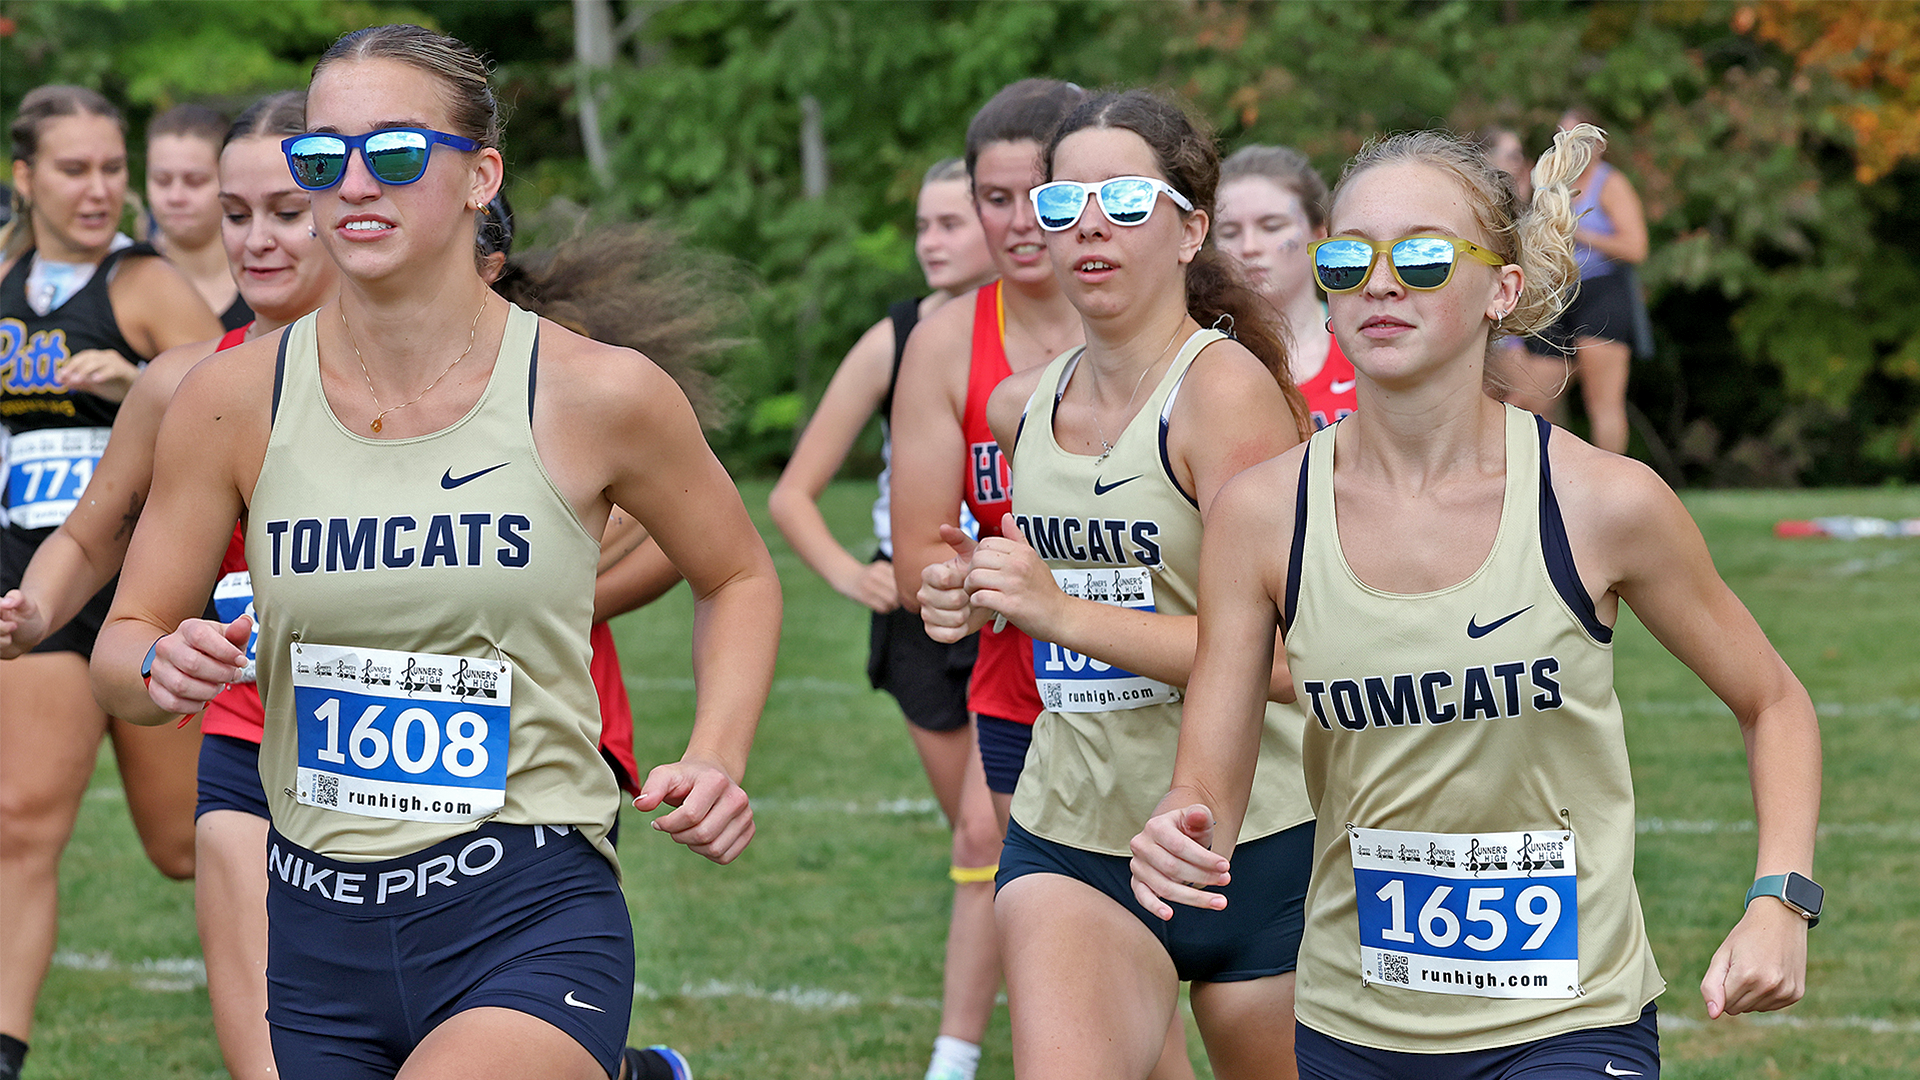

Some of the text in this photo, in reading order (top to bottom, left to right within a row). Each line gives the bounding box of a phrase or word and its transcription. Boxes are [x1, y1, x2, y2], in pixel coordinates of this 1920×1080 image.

[266, 511, 532, 577] TOMCATS
[1012, 514, 1162, 566] OMCATS
[473, 679, 496, 689] HIGH
[1068, 687, 1154, 705] runhigh.com
[1303, 656, 1564, 731] TOMCATS
[313, 698, 489, 778] 1608
[349, 790, 472, 815] runhigh.com
[268, 836, 505, 905] NIKE PRO
[1484, 854, 1506, 862] HIGH
[1538, 852, 1562, 860] HIGH
[1375, 879, 1562, 951] 1659
[1421, 967, 1548, 989] runhigh.com
